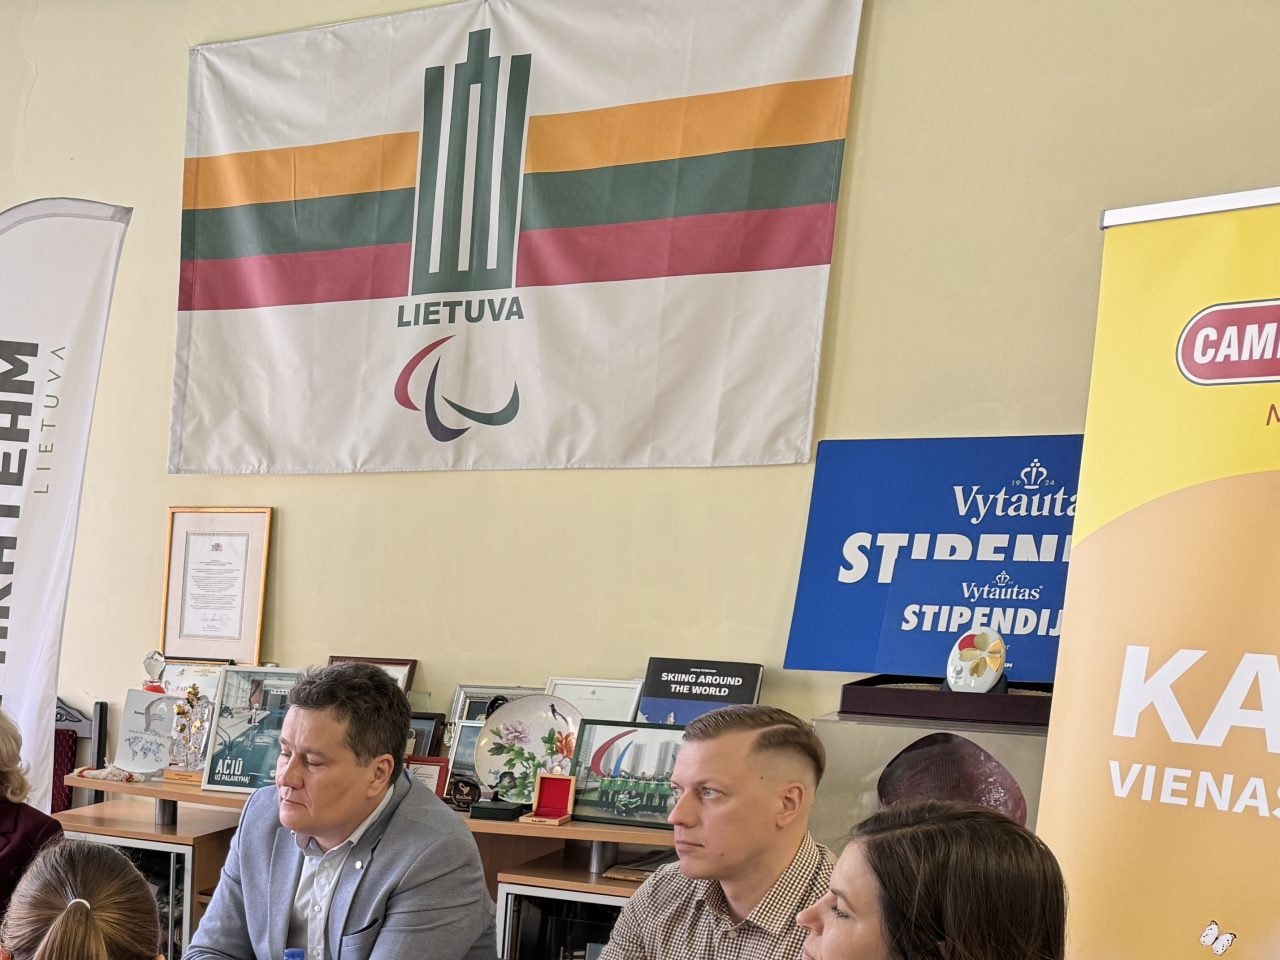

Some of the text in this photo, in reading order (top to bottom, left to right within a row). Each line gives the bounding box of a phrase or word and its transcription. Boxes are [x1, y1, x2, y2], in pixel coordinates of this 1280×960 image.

[397, 296, 525, 328] LIETUVA
[1193, 322, 1280, 364] CAM
[33, 346, 66, 494] LIETUVA
[962, 582, 1041, 602] Vytautas
[661, 672, 743, 686] SKIING AROUND
[670, 684, 729, 696] THE WORLD
